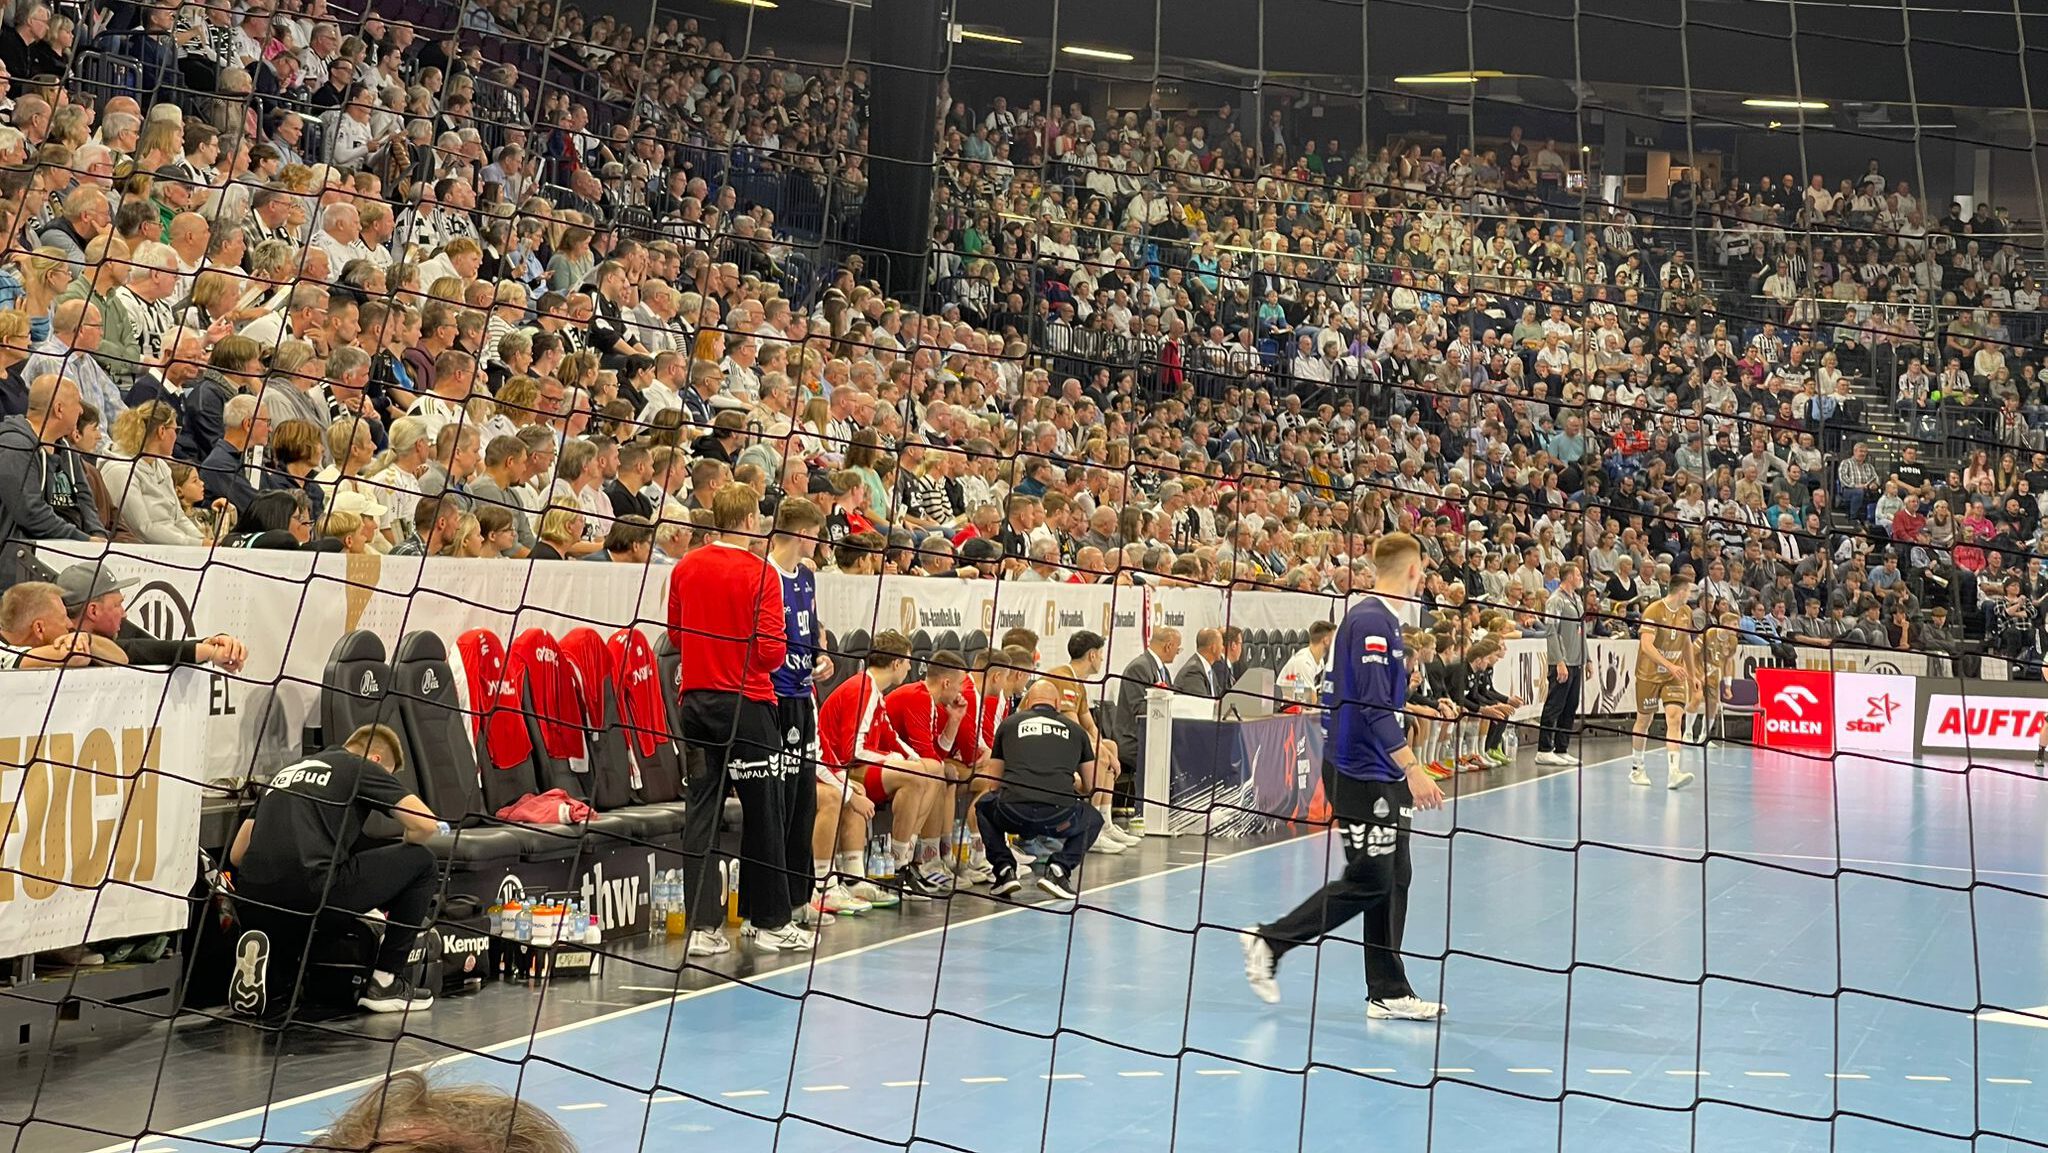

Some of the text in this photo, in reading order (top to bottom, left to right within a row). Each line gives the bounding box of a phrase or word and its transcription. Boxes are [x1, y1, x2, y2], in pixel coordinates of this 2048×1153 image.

[797, 610, 810, 636] 90
[1022, 724, 1070, 740] ReBud
[1766, 718, 1822, 735] ORLEN
[1845, 716, 1885, 734] star
